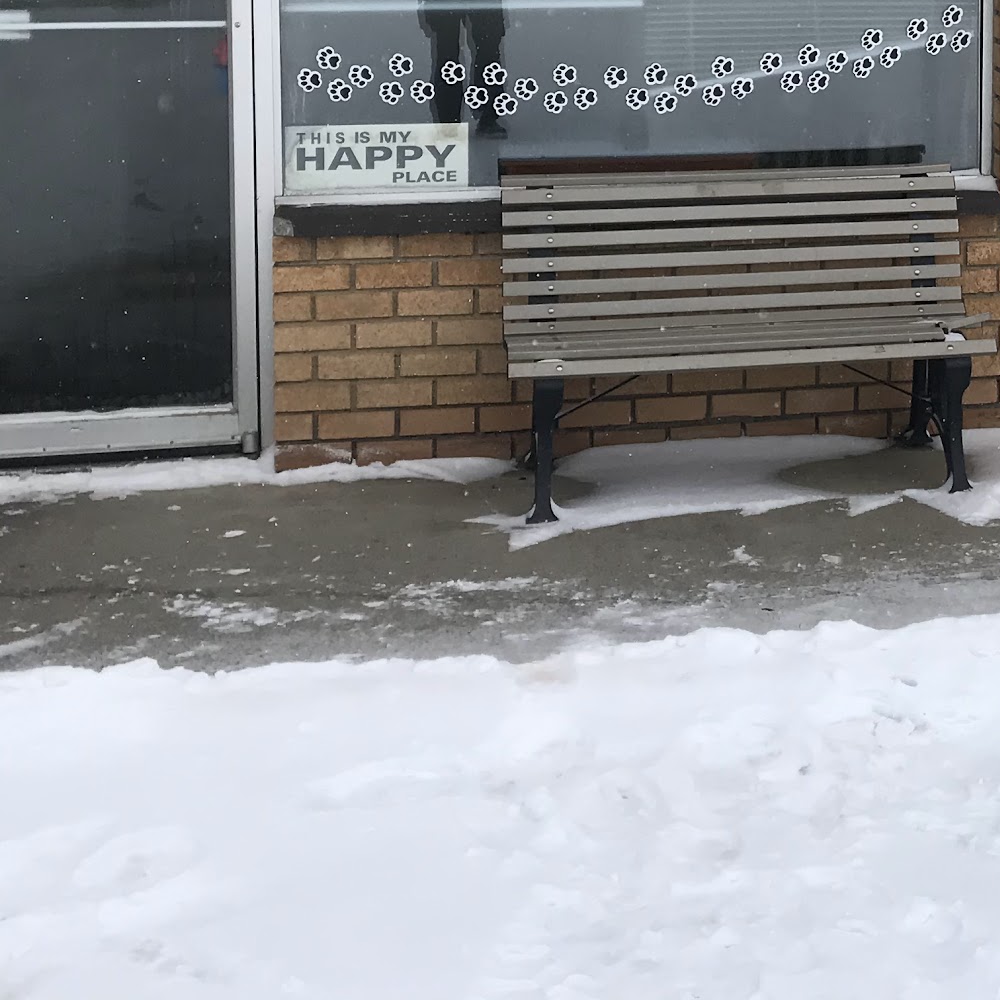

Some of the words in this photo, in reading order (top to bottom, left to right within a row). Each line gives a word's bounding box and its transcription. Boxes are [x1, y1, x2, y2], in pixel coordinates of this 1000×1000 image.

[296, 132, 345, 144] THIS
[354, 131, 371, 144] IS
[379, 130, 412, 143] MY
[296, 144, 457, 171] HAPPY
[392, 170, 457, 184] PLACE
